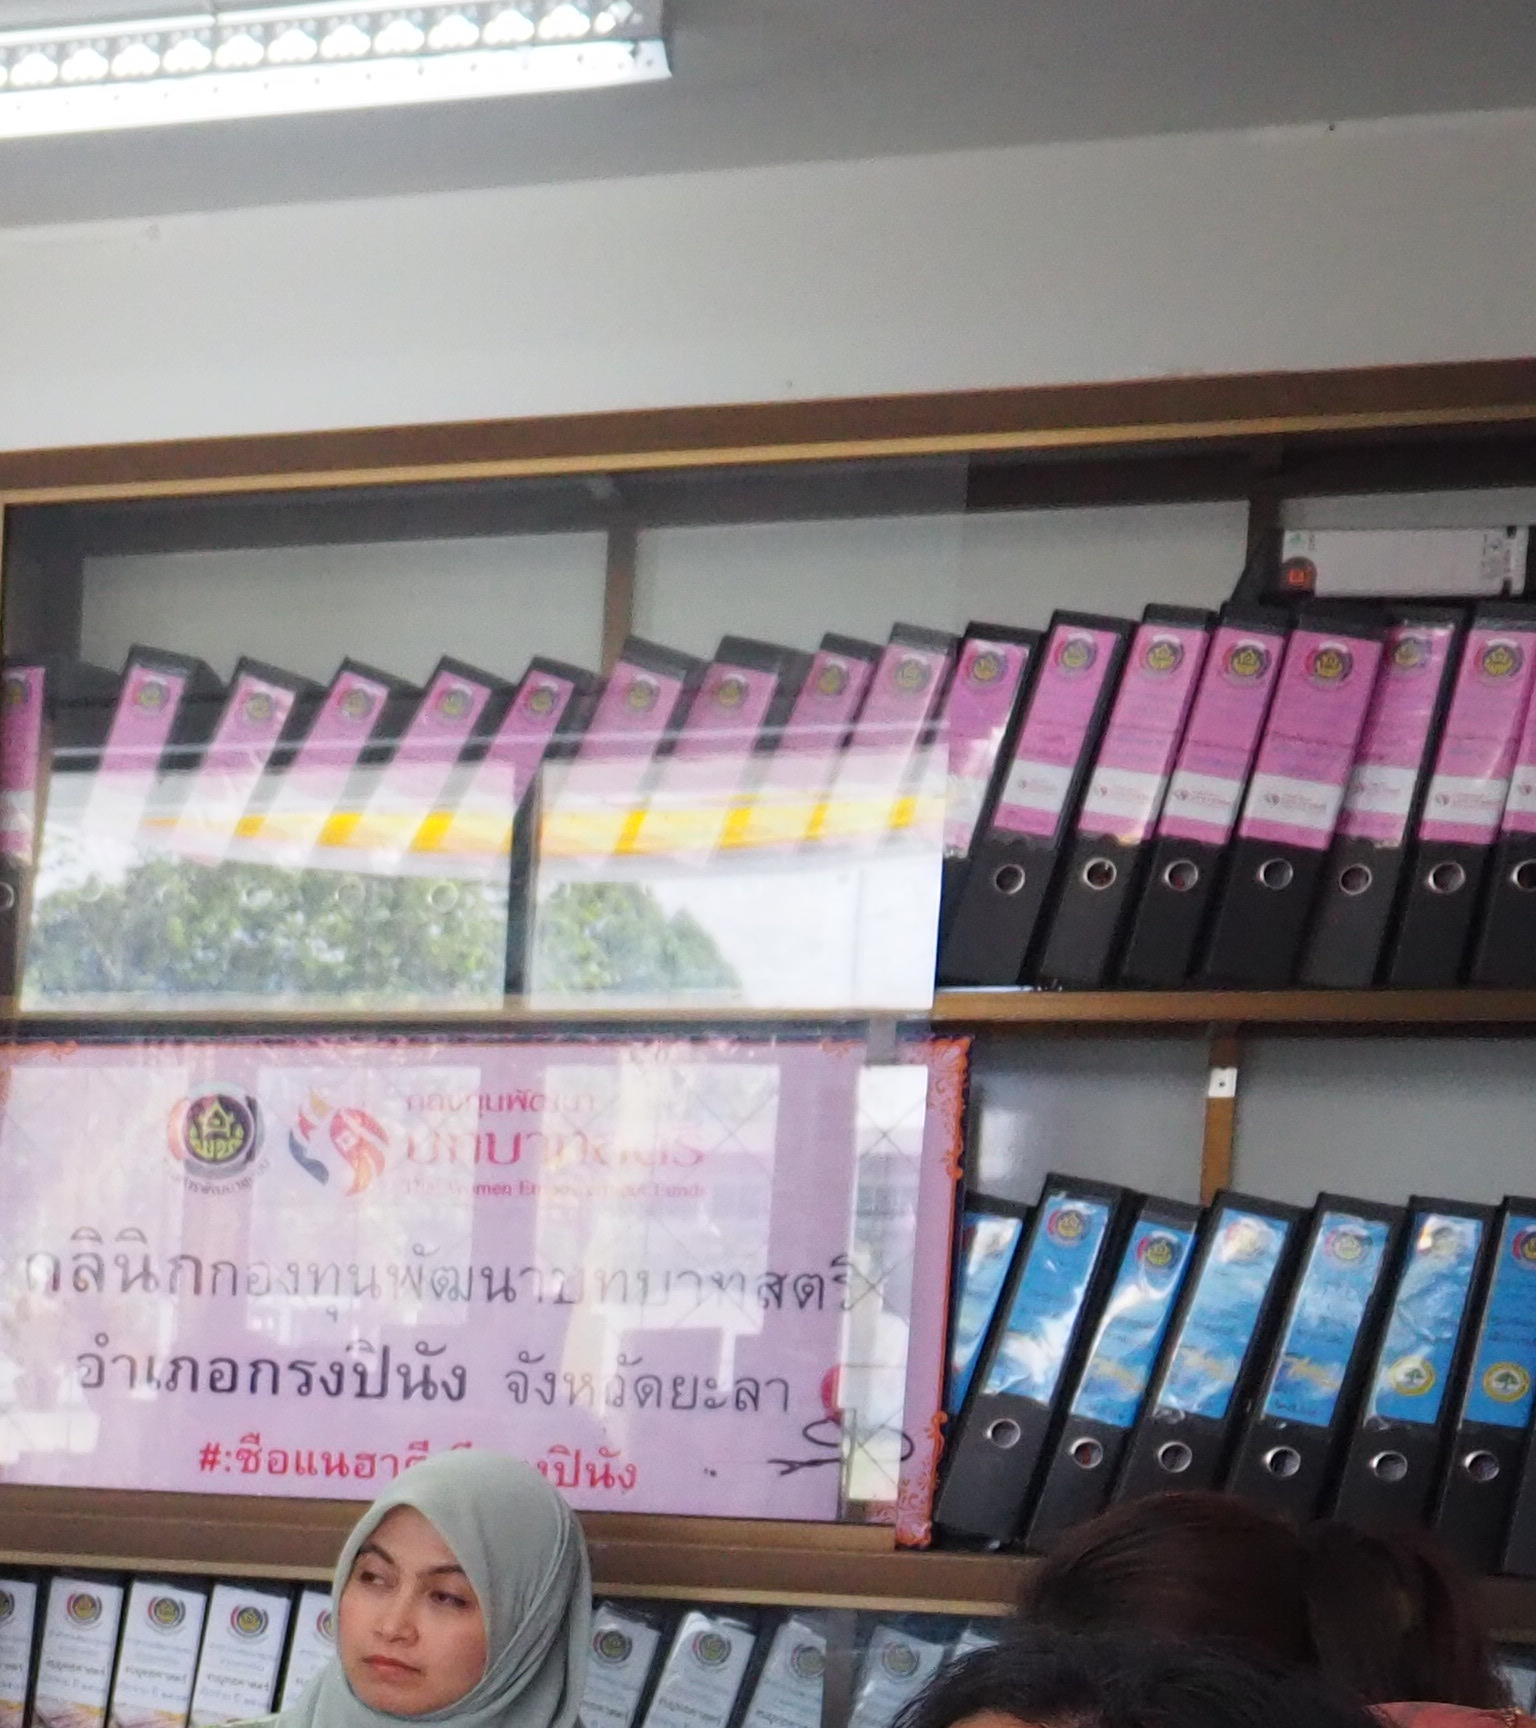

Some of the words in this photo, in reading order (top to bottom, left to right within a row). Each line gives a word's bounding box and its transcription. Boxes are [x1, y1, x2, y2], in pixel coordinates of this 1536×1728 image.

[505, 1350, 791, 1412] จังหวัดยะลา
